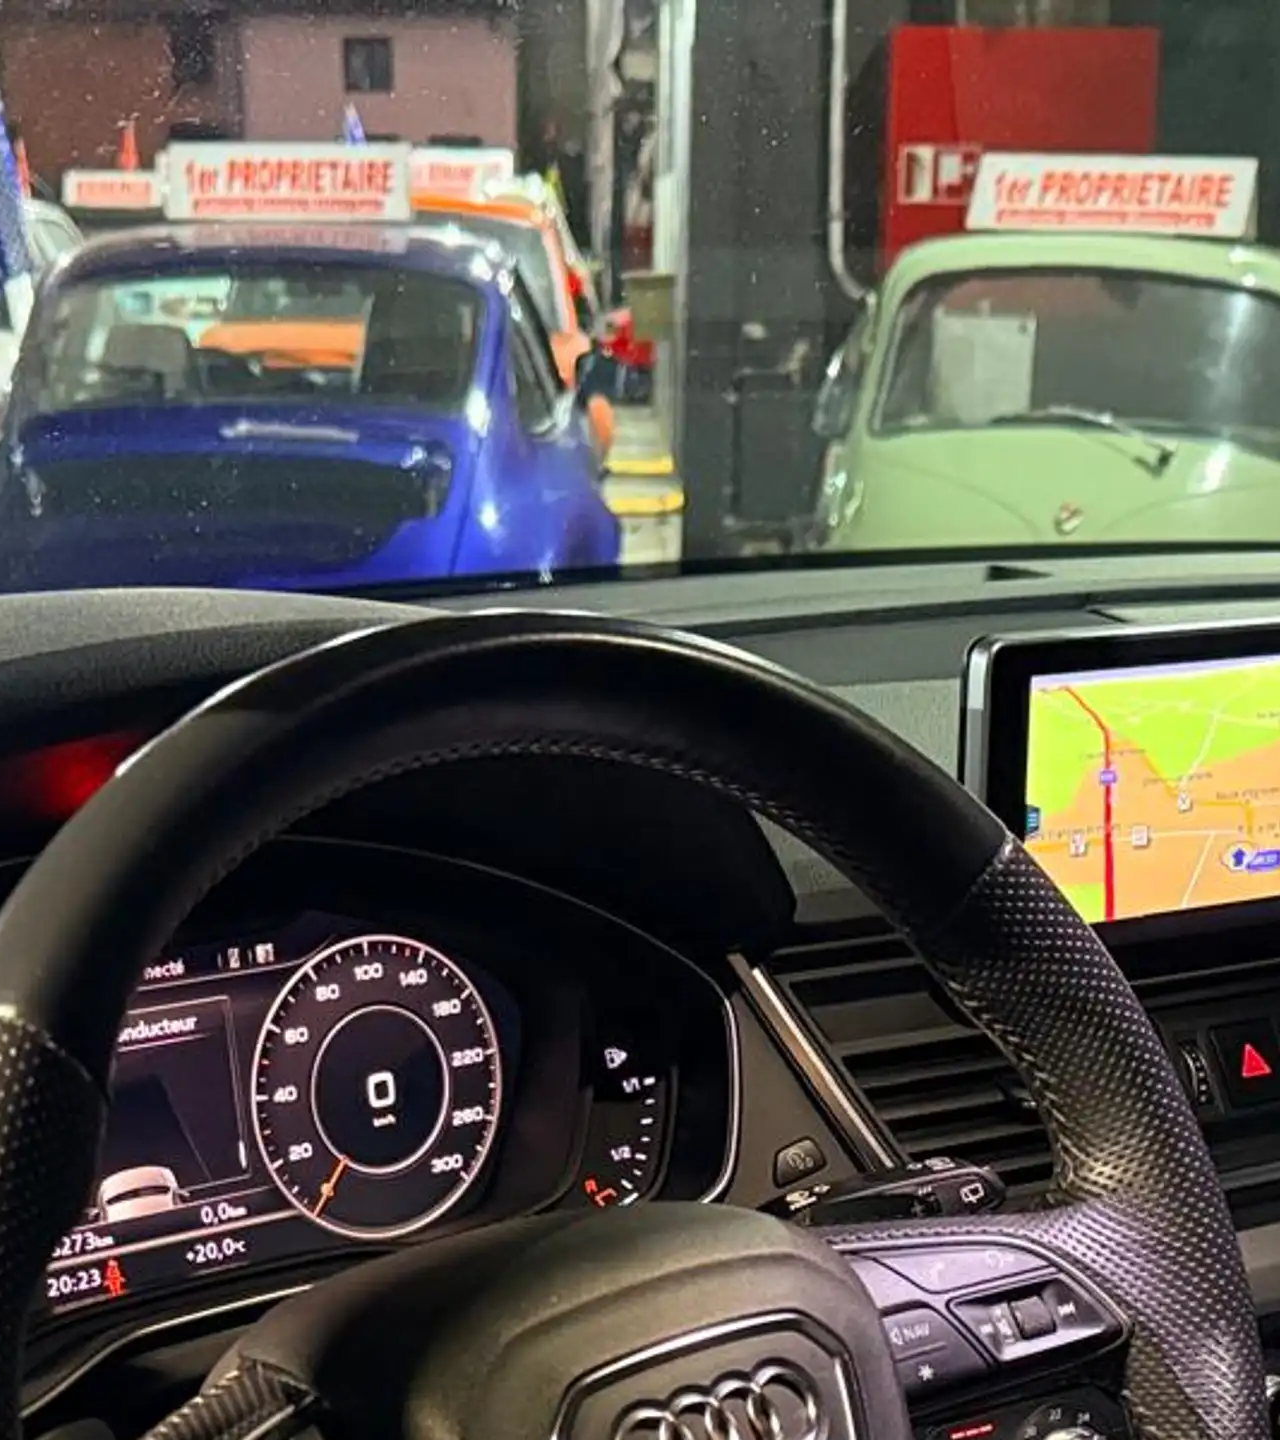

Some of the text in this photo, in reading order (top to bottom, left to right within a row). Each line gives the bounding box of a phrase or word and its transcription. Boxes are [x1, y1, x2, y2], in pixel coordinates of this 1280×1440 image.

[186, 160, 217, 194] 1er
[227, 160, 394, 194] PROPRIETAIRE
[995, 171, 1235, 208] 1er PROPRIETAIRE
[353, 962, 384, 982] 100
[399, 968, 428, 988] 140
[315, 983, 340, 1002] 80
[432, 999, 462, 1018] 180
[284, 1026, 309, 1046] 60
[451, 1048, 485, 1067] 220
[273, 1085, 298, 1104] 40
[367, 1071, 397, 1108] 0
[451, 1107, 485, 1127] 260
[288, 1142, 313, 1161] 20
[430, 1154, 463, 1174] 300
[47, 1271, 102, 1298] 20:23
